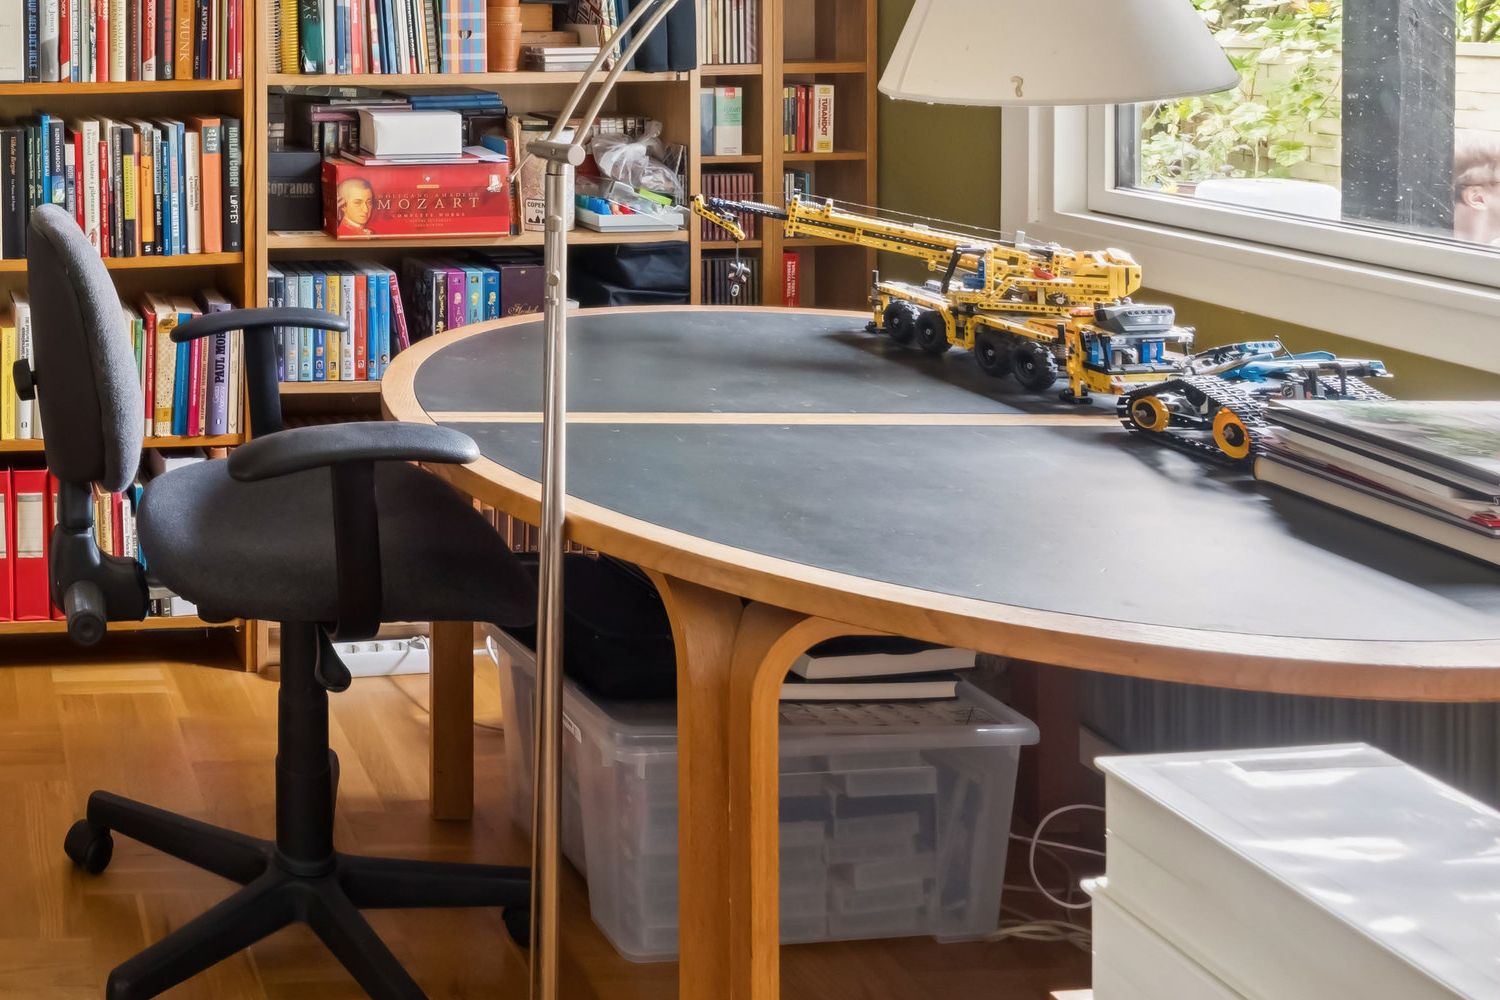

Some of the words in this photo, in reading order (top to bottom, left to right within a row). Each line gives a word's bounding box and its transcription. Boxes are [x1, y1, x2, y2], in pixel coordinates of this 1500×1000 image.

[28, 14, 37, 33] MED
[28, 33, 37, 48] DET
[179, 17, 190, 62] MUNK
[29, 49, 37, 68] HELE
[820, 98, 828, 136] TURANDOT
[228, 126, 239, 160] HARLAN
[229, 160, 239, 187] COBEN
[229, 194, 239, 225] LØFTET
[376, 197, 481, 211] MOZART
